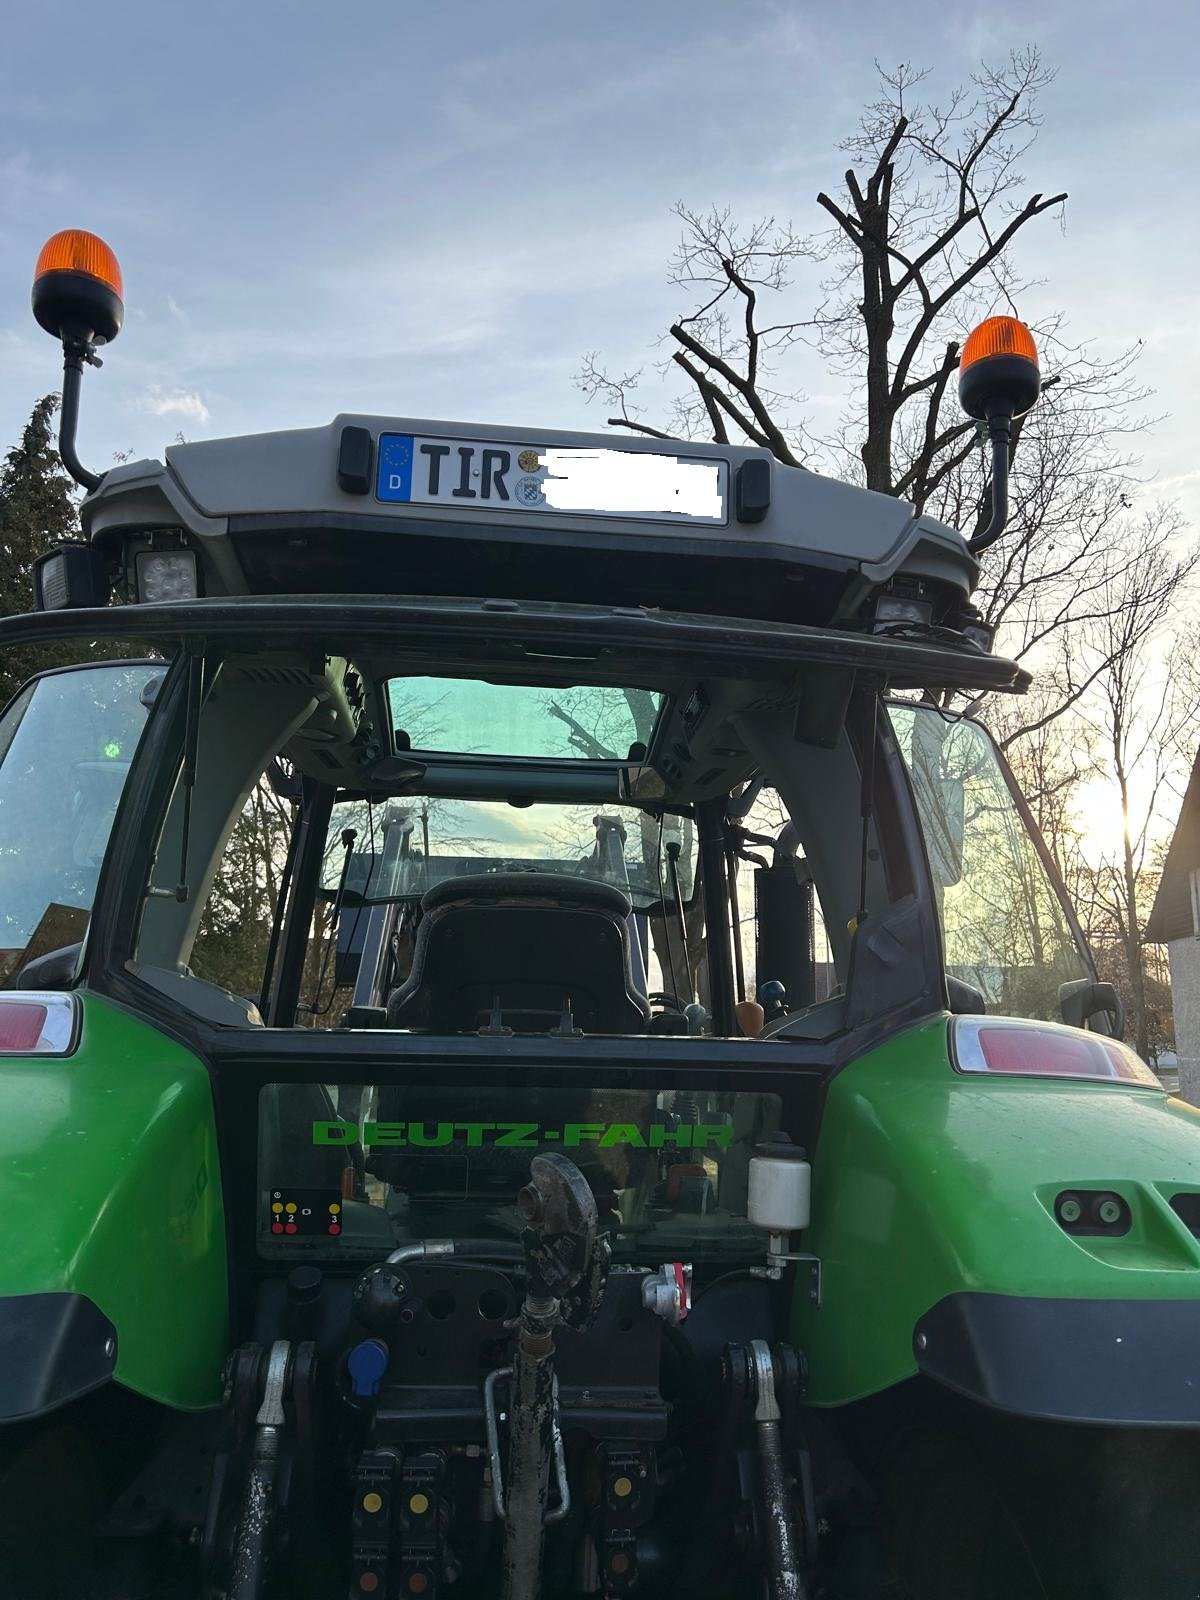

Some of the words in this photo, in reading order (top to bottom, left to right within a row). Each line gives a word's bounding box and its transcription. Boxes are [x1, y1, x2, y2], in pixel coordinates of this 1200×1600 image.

[389, 474, 401, 489] D
[420, 444, 510, 501] TIR
[313, 1121, 734, 1148] DEUTZ-FAHR
[274, 1214, 280, 1222] 1
[288, 1214, 294, 1222] 2
[331, 1215, 338, 1223] 3
